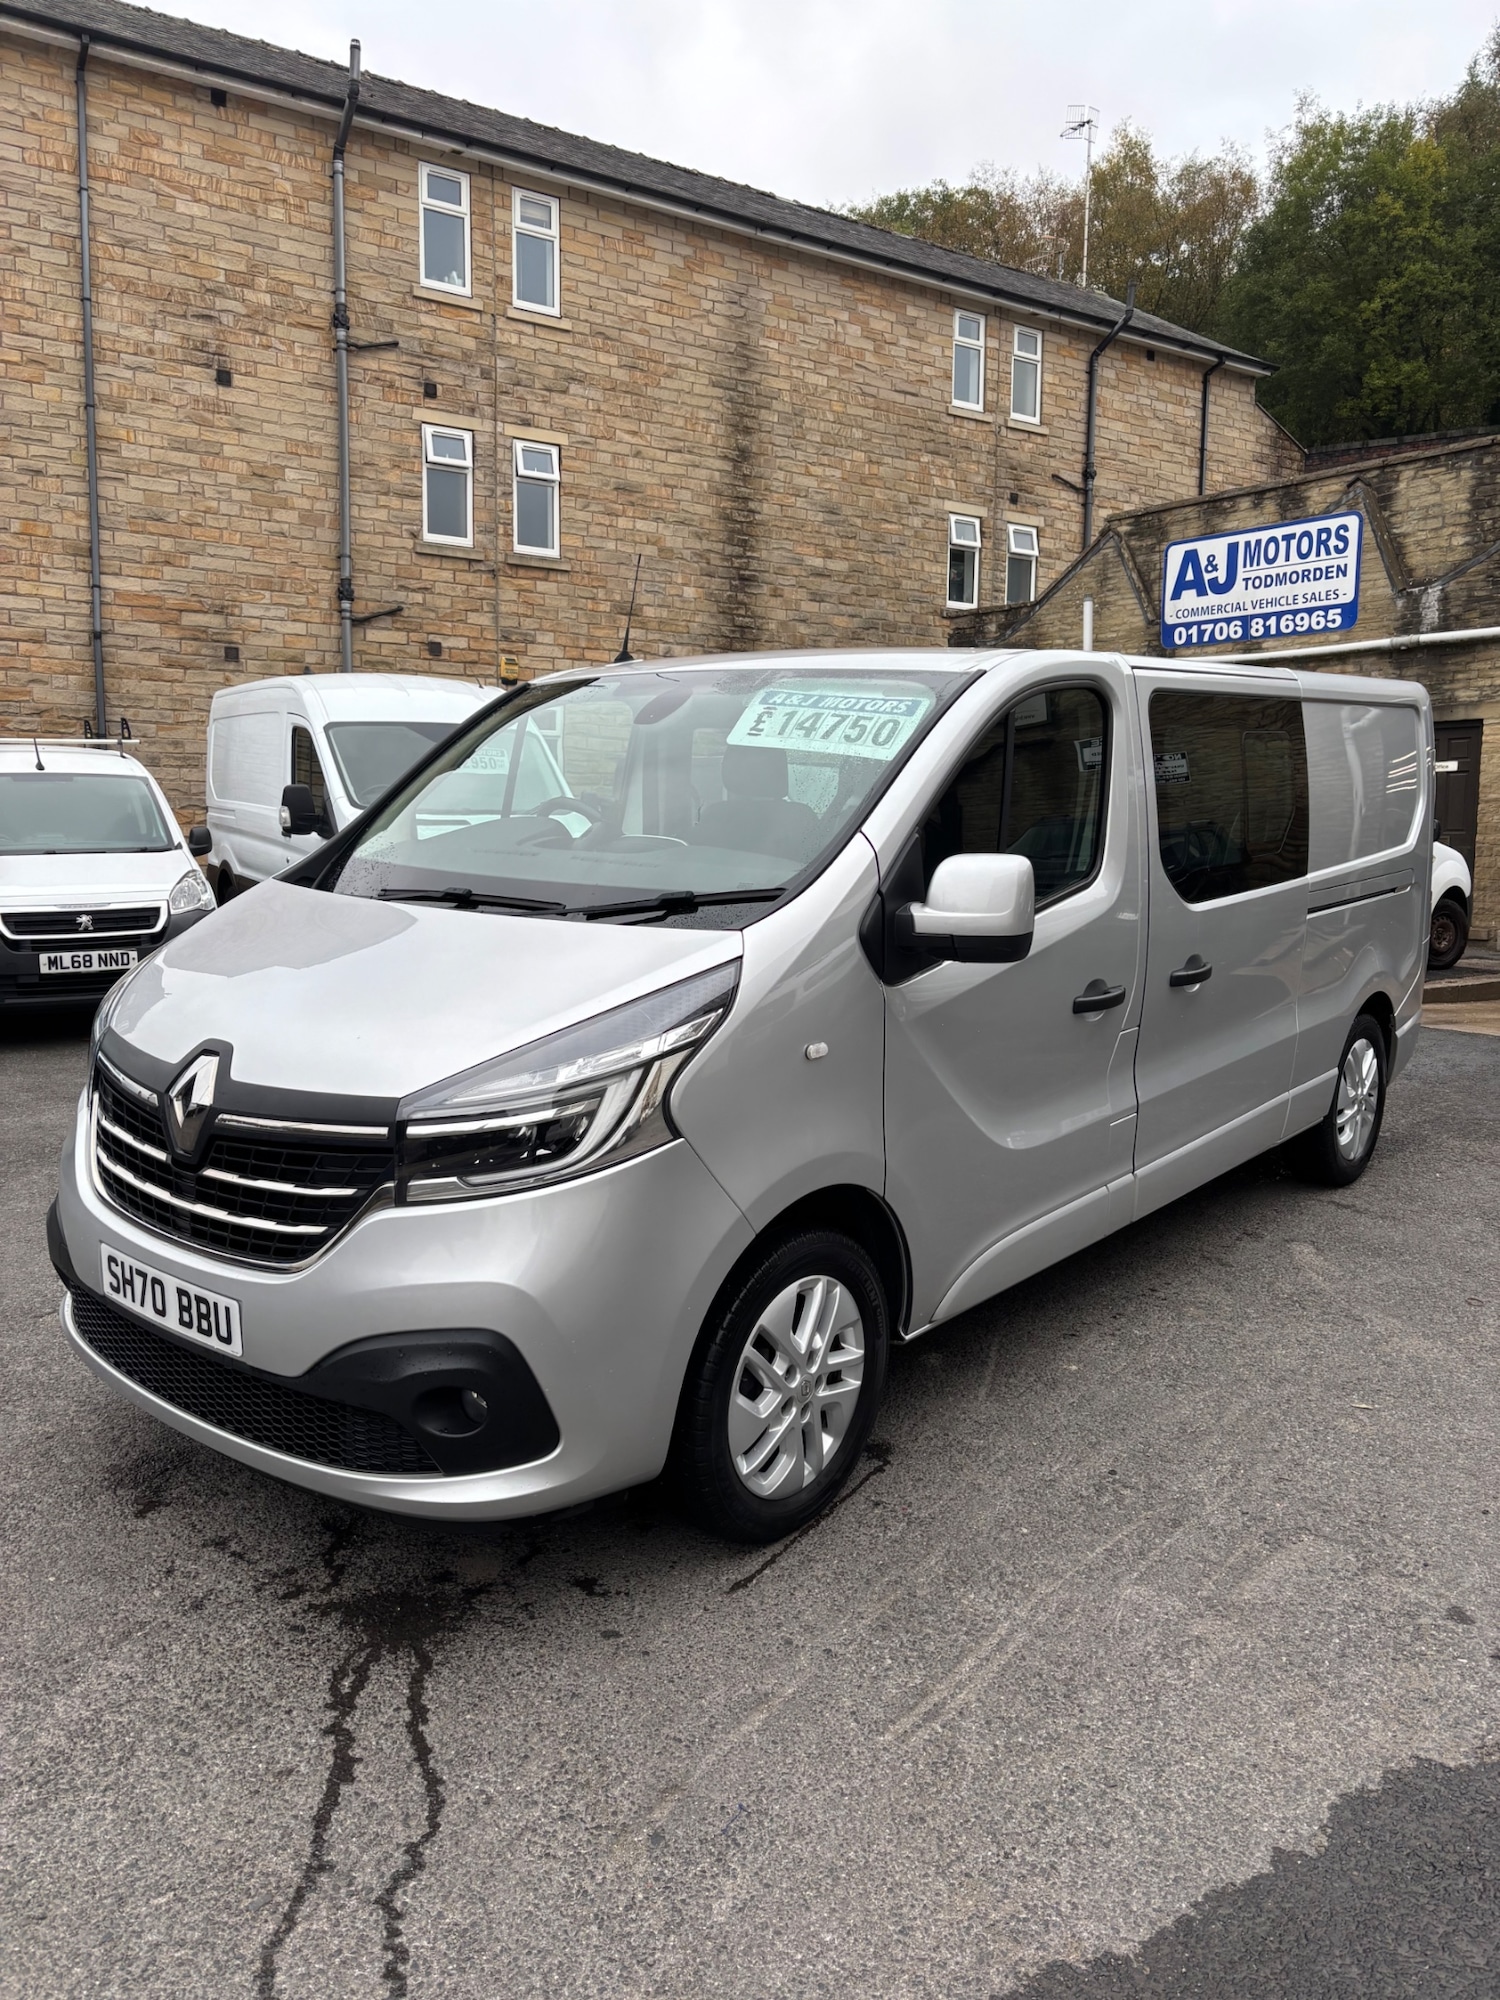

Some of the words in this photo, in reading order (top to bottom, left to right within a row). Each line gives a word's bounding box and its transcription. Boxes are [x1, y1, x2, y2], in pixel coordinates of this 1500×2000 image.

[1170, 541, 1240, 601] A&J
[1242, 524, 1349, 568] MOTORS
[1242, 563, 1348, 591] TODMORDEN
[1175, 601, 1248, 620] COMMERCIAL
[1250, 595, 1299, 610] VEHICLE
[1302, 589, 1339, 604] SALES
[1173, 621, 1243, 645] 01706
[1250, 608, 1342, 637] 816965
[769, 693, 818, 706] A&J
[821, 696, 912, 713] MOTORS
[47, 954, 93, 971] ML68
[98, 952, 130, 968] NND
[107, 1255, 167, 1318] SH70
[176, 1286, 232, 1345] BBU
